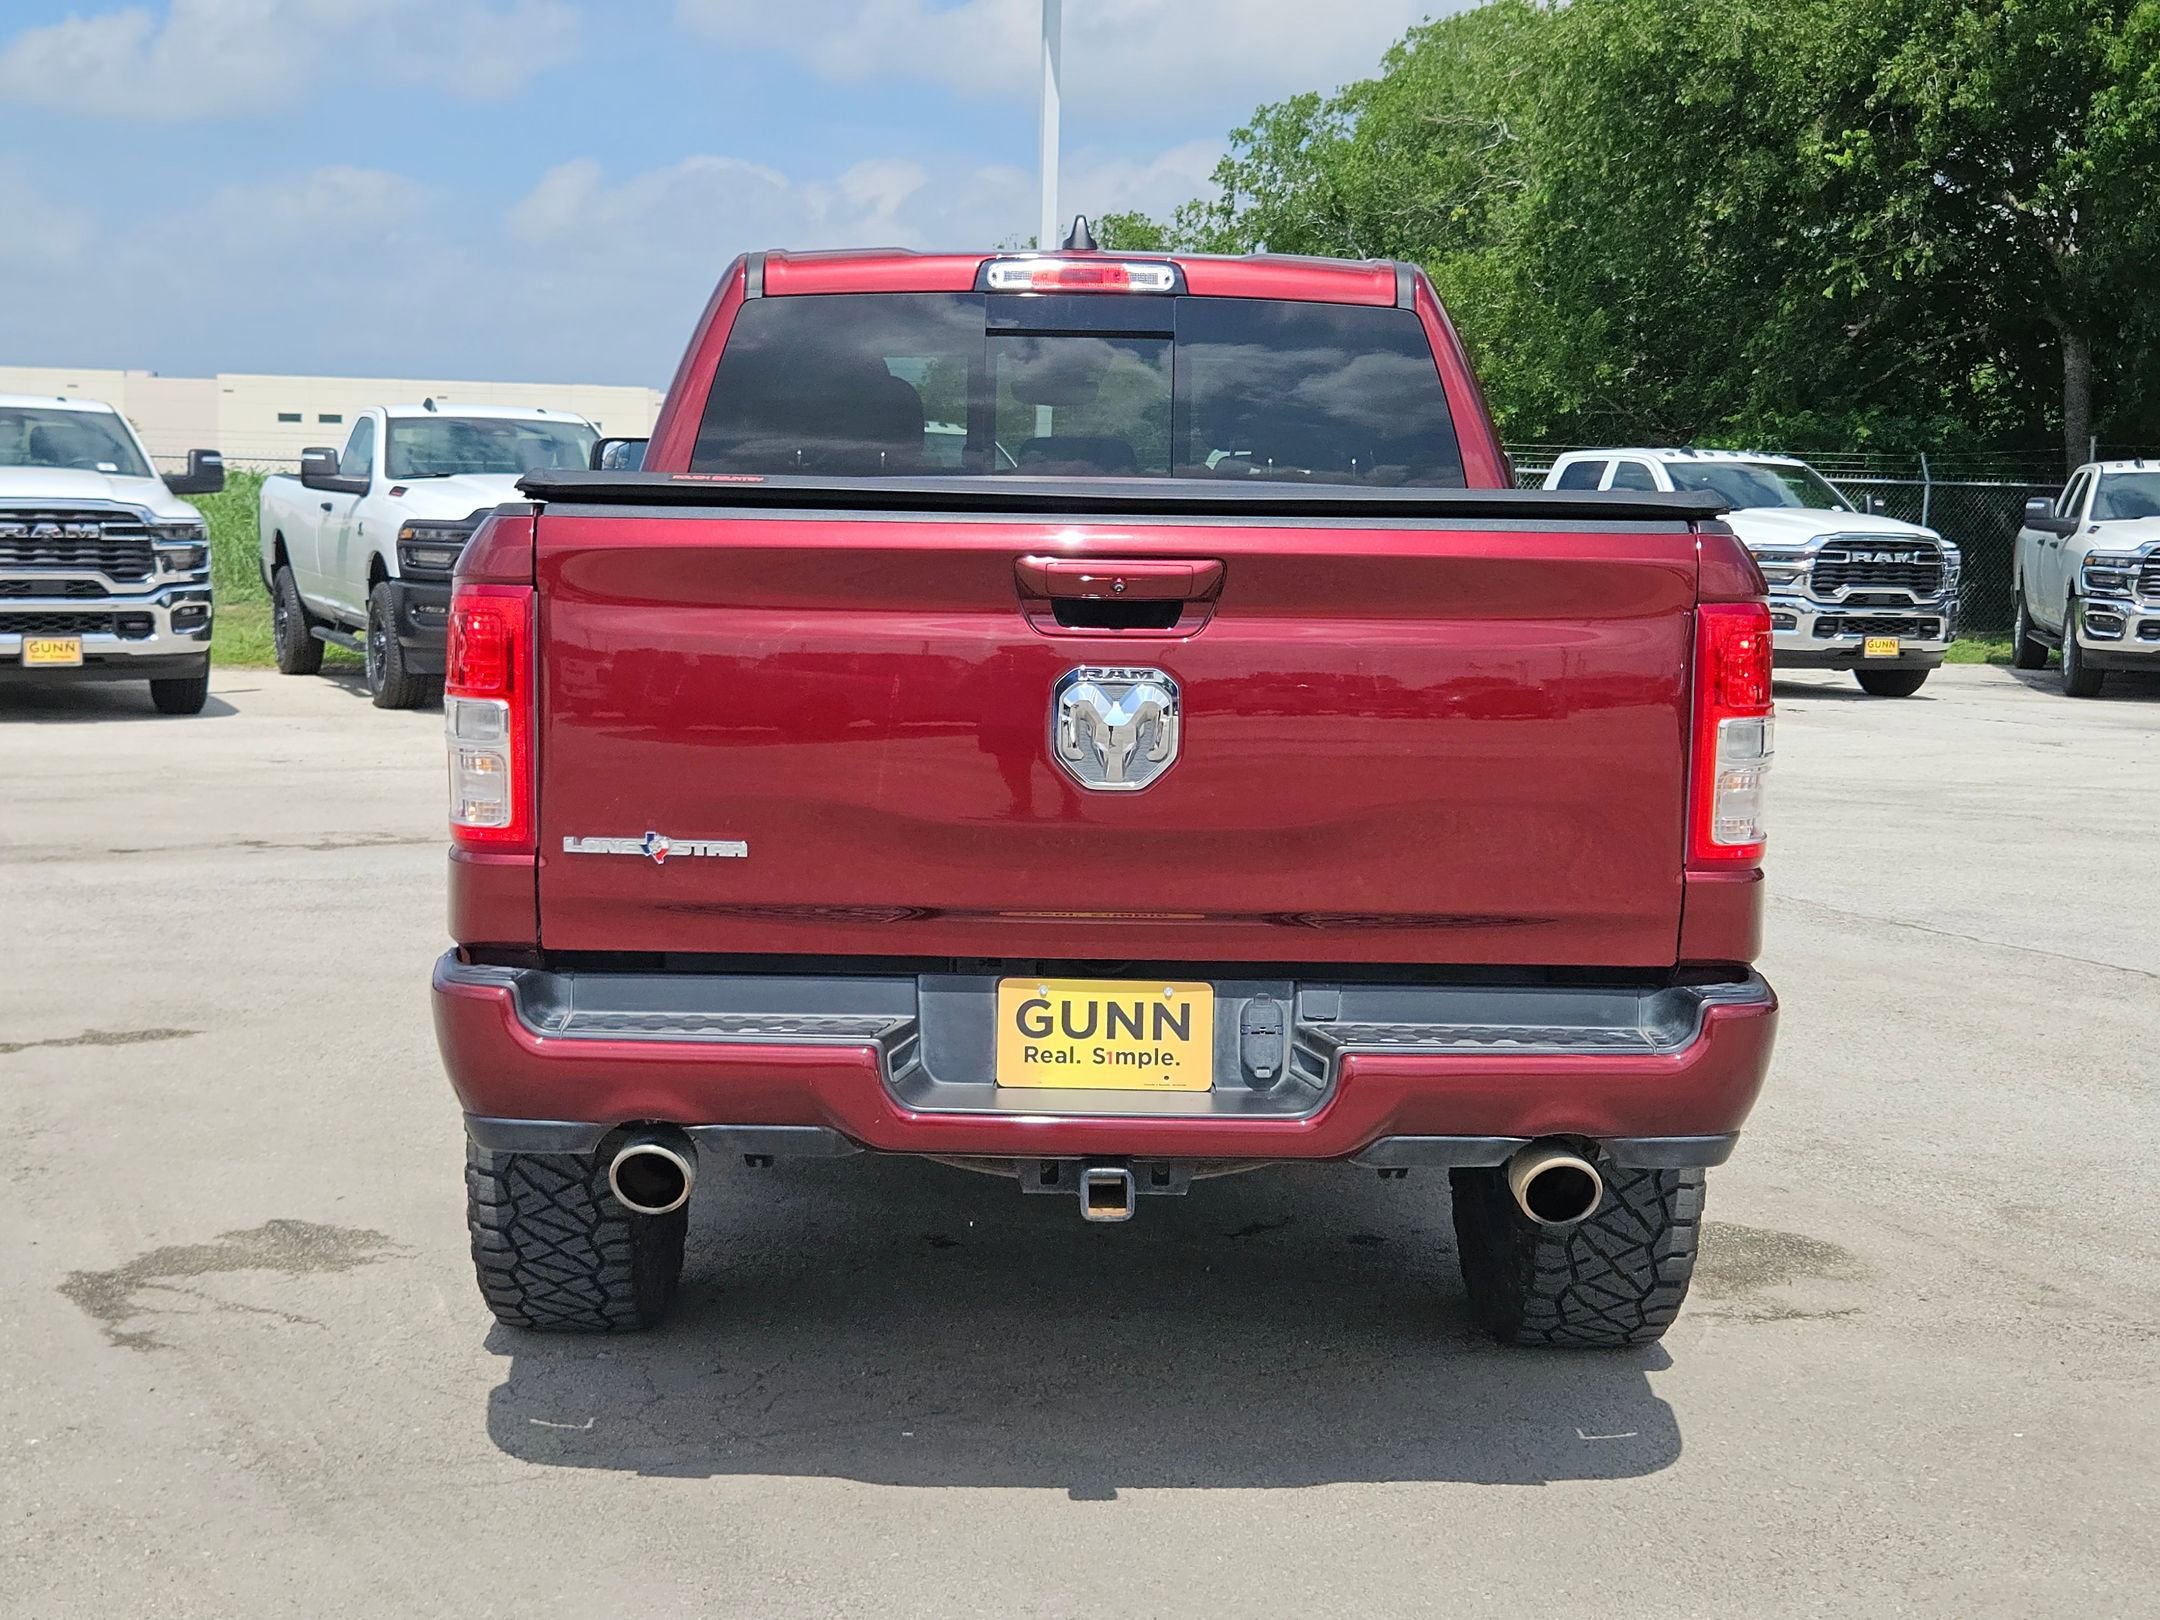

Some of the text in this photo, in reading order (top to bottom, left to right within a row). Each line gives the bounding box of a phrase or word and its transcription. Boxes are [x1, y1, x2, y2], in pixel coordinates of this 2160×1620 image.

[0, 523, 99, 538] RAM
[1851, 551, 1915, 563] RAM
[29, 641, 76, 653] GUNN
[1867, 640, 1896, 649] GUNN
[1078, 668, 1155, 680] RAM
[1016, 998, 1190, 1042] GUNN
[1024, 1045, 1081, 1065] Real.
